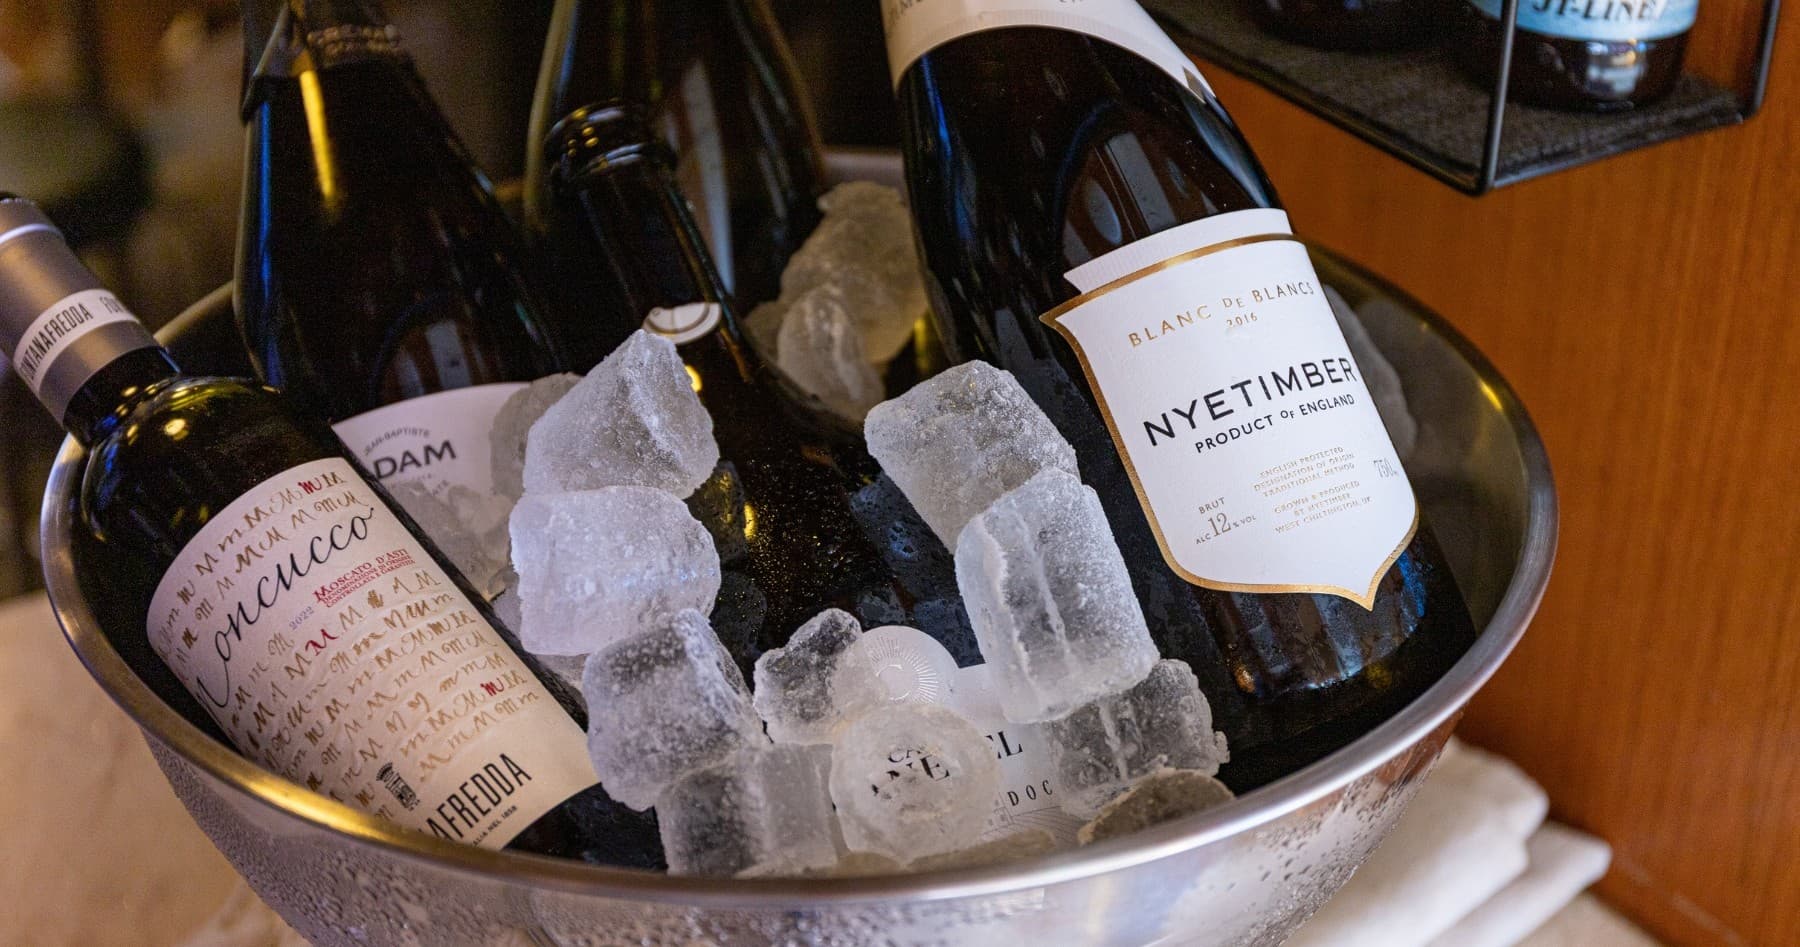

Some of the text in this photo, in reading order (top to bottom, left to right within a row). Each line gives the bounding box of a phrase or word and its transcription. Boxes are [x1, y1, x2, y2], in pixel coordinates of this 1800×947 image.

[1128, 305, 1212, 348] BLANC
[1251, 281, 1314, 304] BLANCS
[1226, 312, 1258, 328] 2016
[1143, 357, 1357, 447] NYETIMBER
[1195, 393, 1355, 453] PRODUCT OF ENGLAND
[373, 440, 457, 480] DAM
[1253, 465, 1314, 491] DESIGNATION
[1259, 446, 1344, 479] ENGLISH PROTECTED
[1198, 496, 1225, 515] BRUT
[1195, 532, 1211, 545] ALC
[1240, 515, 1257, 525] VOL
[312, 548, 408, 605] MOSCATO D'ASTI
[418, 753, 533, 841] AFREDDA
